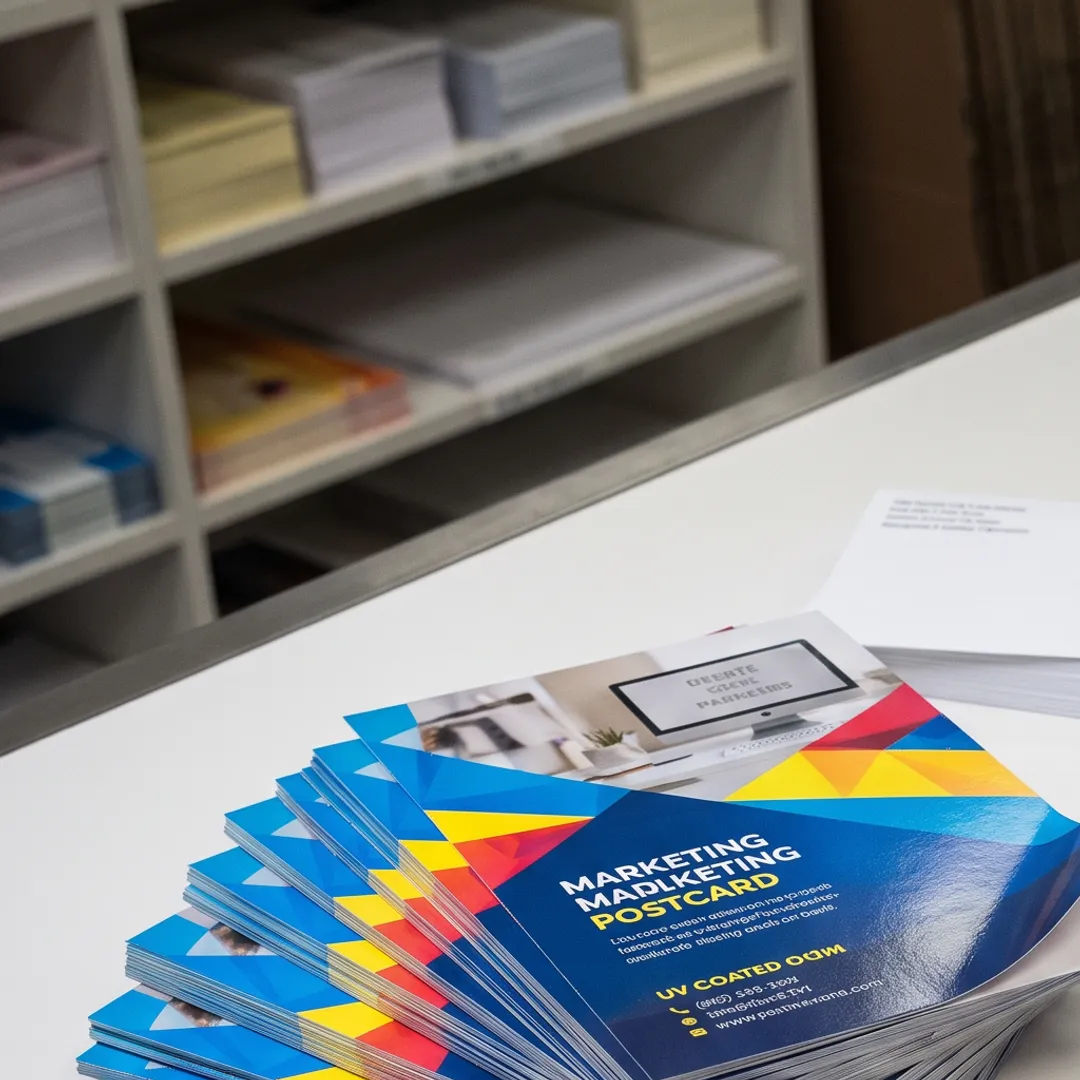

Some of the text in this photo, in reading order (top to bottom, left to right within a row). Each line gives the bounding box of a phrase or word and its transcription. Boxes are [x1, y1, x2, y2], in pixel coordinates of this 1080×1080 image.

[559, 833, 769, 896] MARKETING
[590, 873, 780, 931] POSTCARD
[656, 984, 688, 1000] UV
[693, 960, 782, 991] COATED
